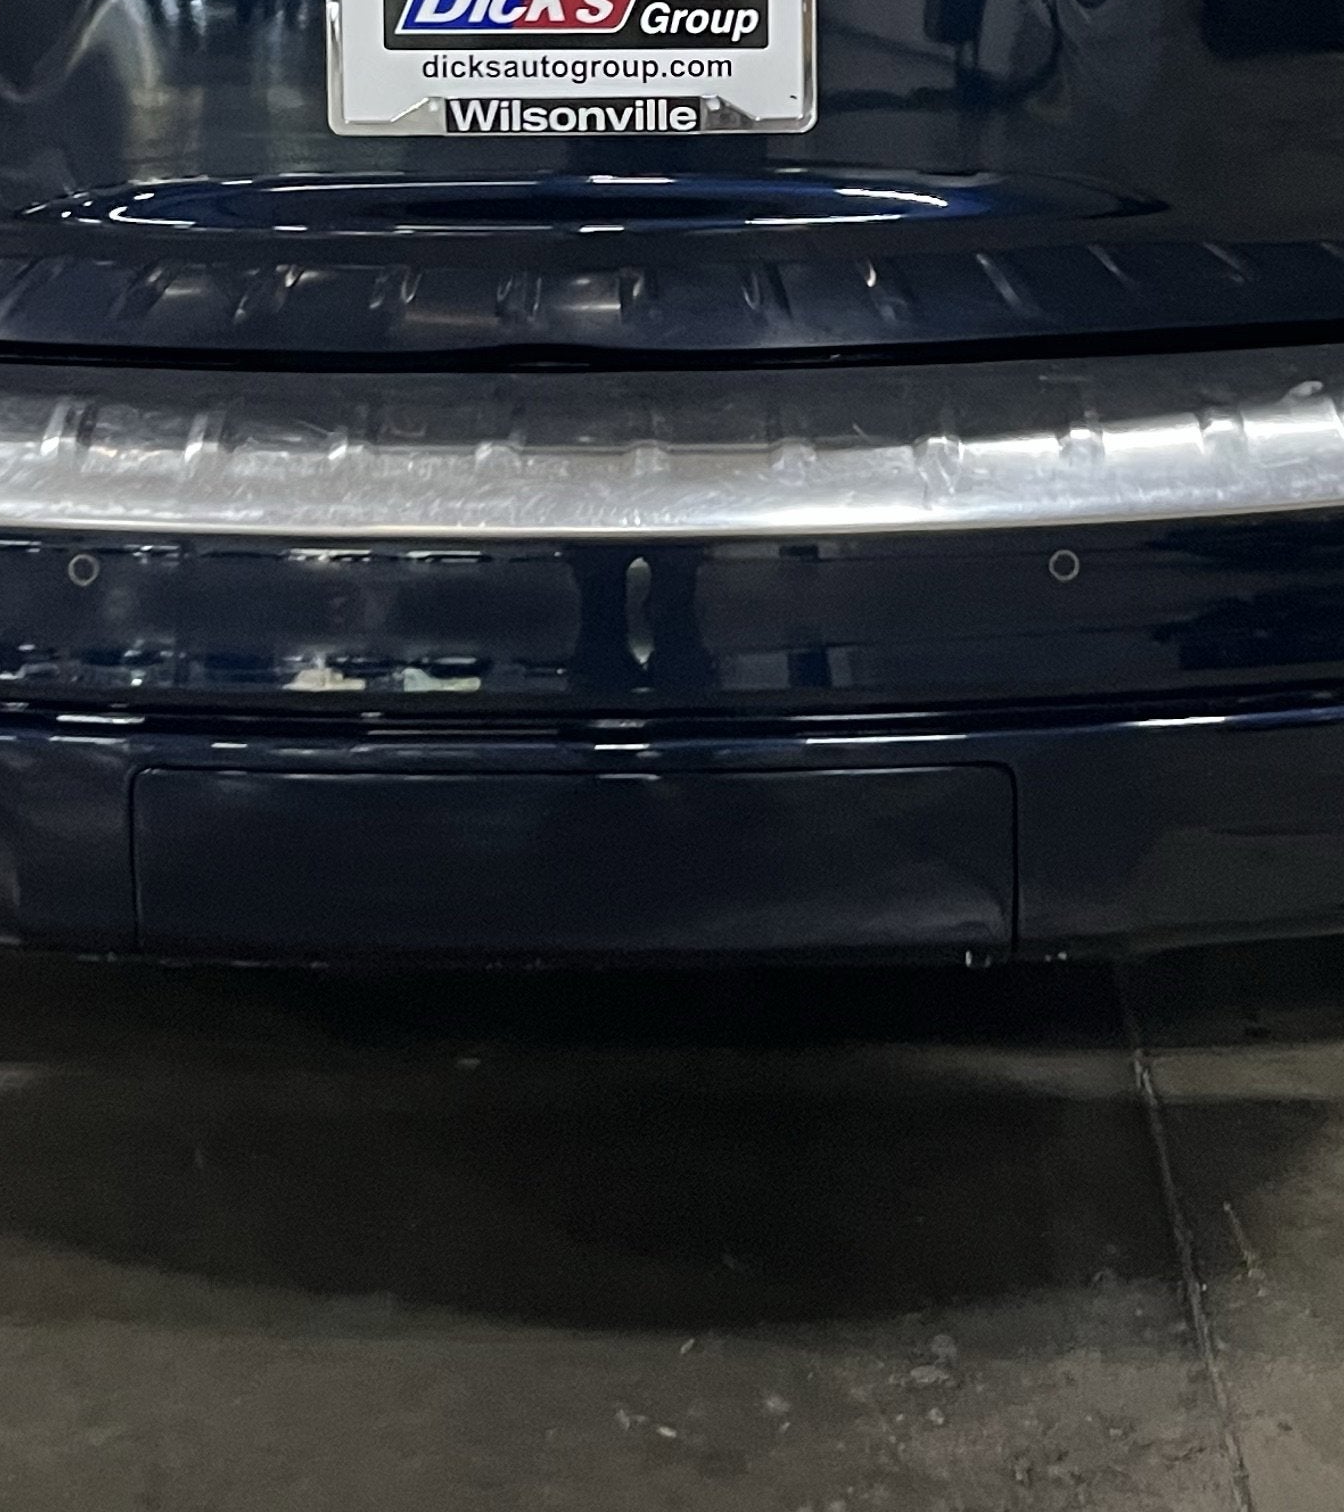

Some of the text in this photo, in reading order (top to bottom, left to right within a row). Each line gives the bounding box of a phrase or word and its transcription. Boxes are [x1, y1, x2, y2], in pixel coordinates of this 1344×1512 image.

[640, 4, 760, 42] Group
[422, 54, 733, 84] dicksautogroup.com
[449, 99, 698, 133] Wilsonville
